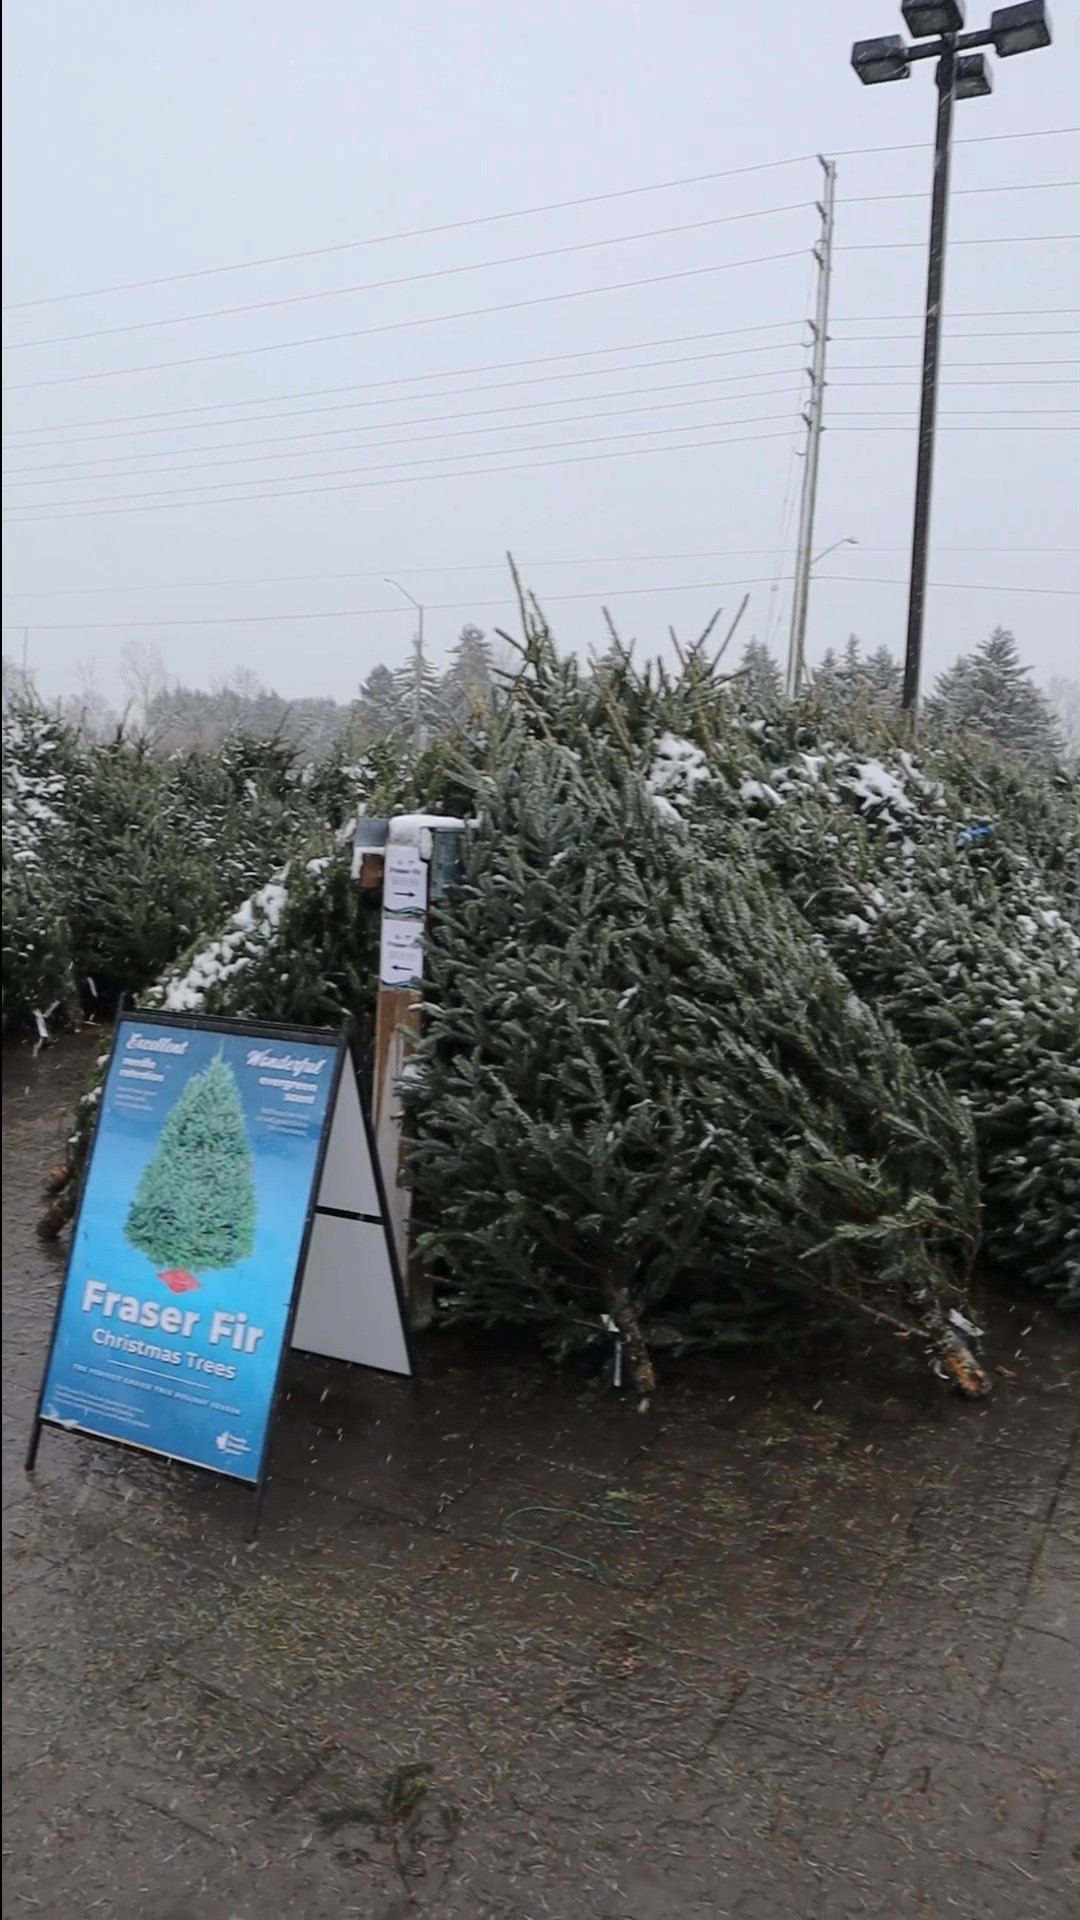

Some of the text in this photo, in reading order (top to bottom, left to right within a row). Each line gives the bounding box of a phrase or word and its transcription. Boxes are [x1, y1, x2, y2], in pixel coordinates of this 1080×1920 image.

[125, 1032, 189, 1055] Excellent
[246, 1048, 327, 1077] Wonderful
[81, 1279, 265, 1354] Fraser Fir
[92, 1328, 237, 1380] Christmas Trees
